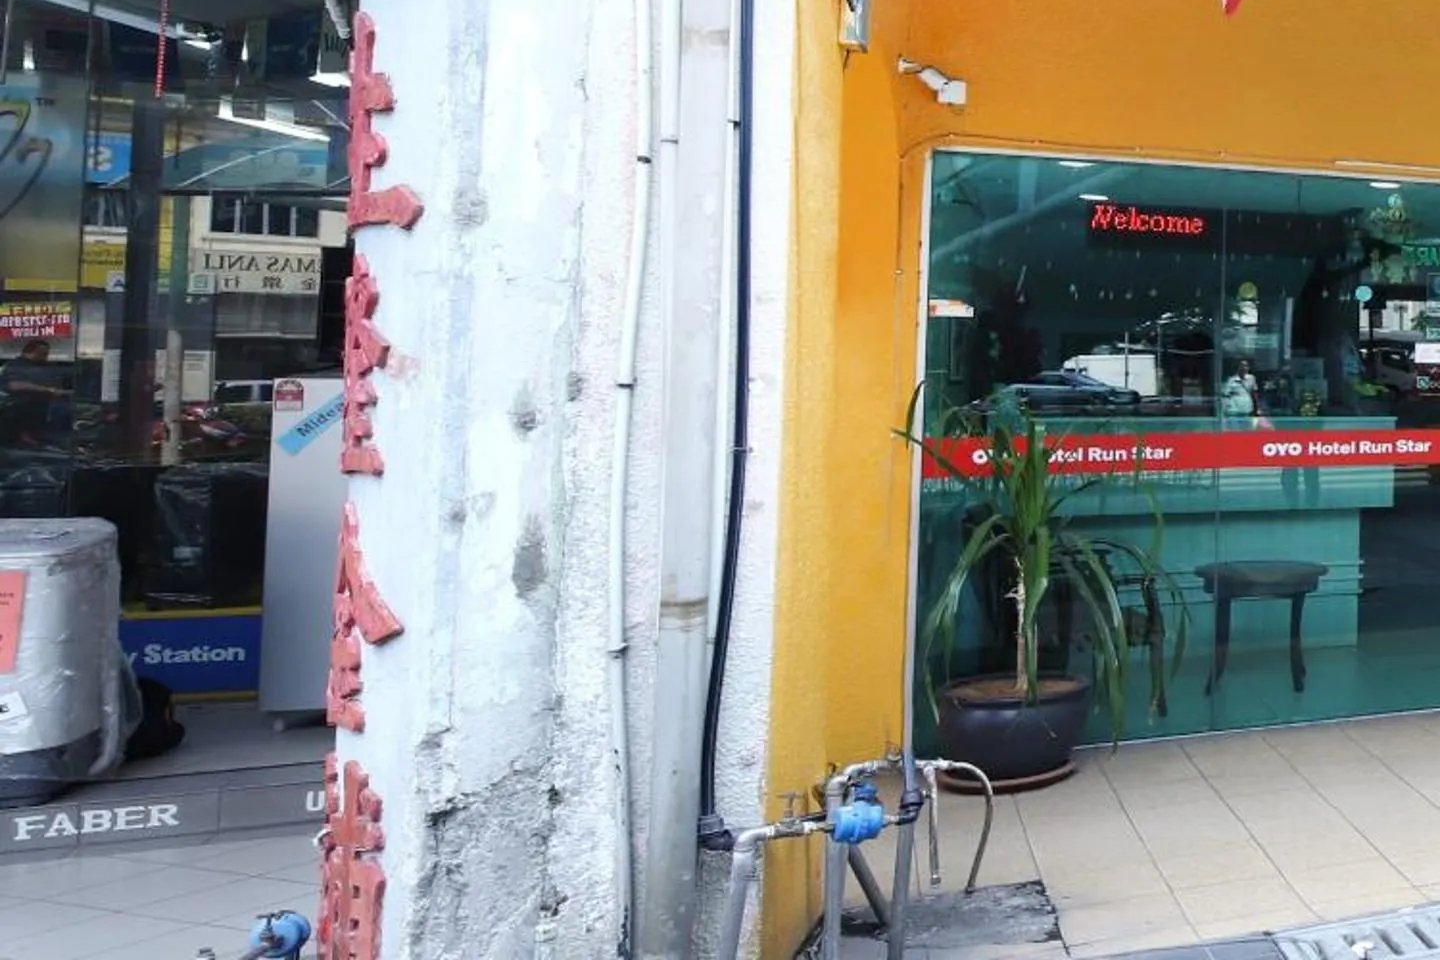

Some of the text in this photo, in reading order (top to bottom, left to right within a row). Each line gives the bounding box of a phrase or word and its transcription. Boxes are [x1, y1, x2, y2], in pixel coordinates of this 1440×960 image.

[1091, 203, 1204, 234] Welcome
[1045, 448, 1083, 464] otel
[1088, 447, 1127, 463] Run
[1262, 438, 1432, 457] OYO Hotel Run Star
[144, 643, 246, 665] Station
[14, 803, 181, 842] FABER
